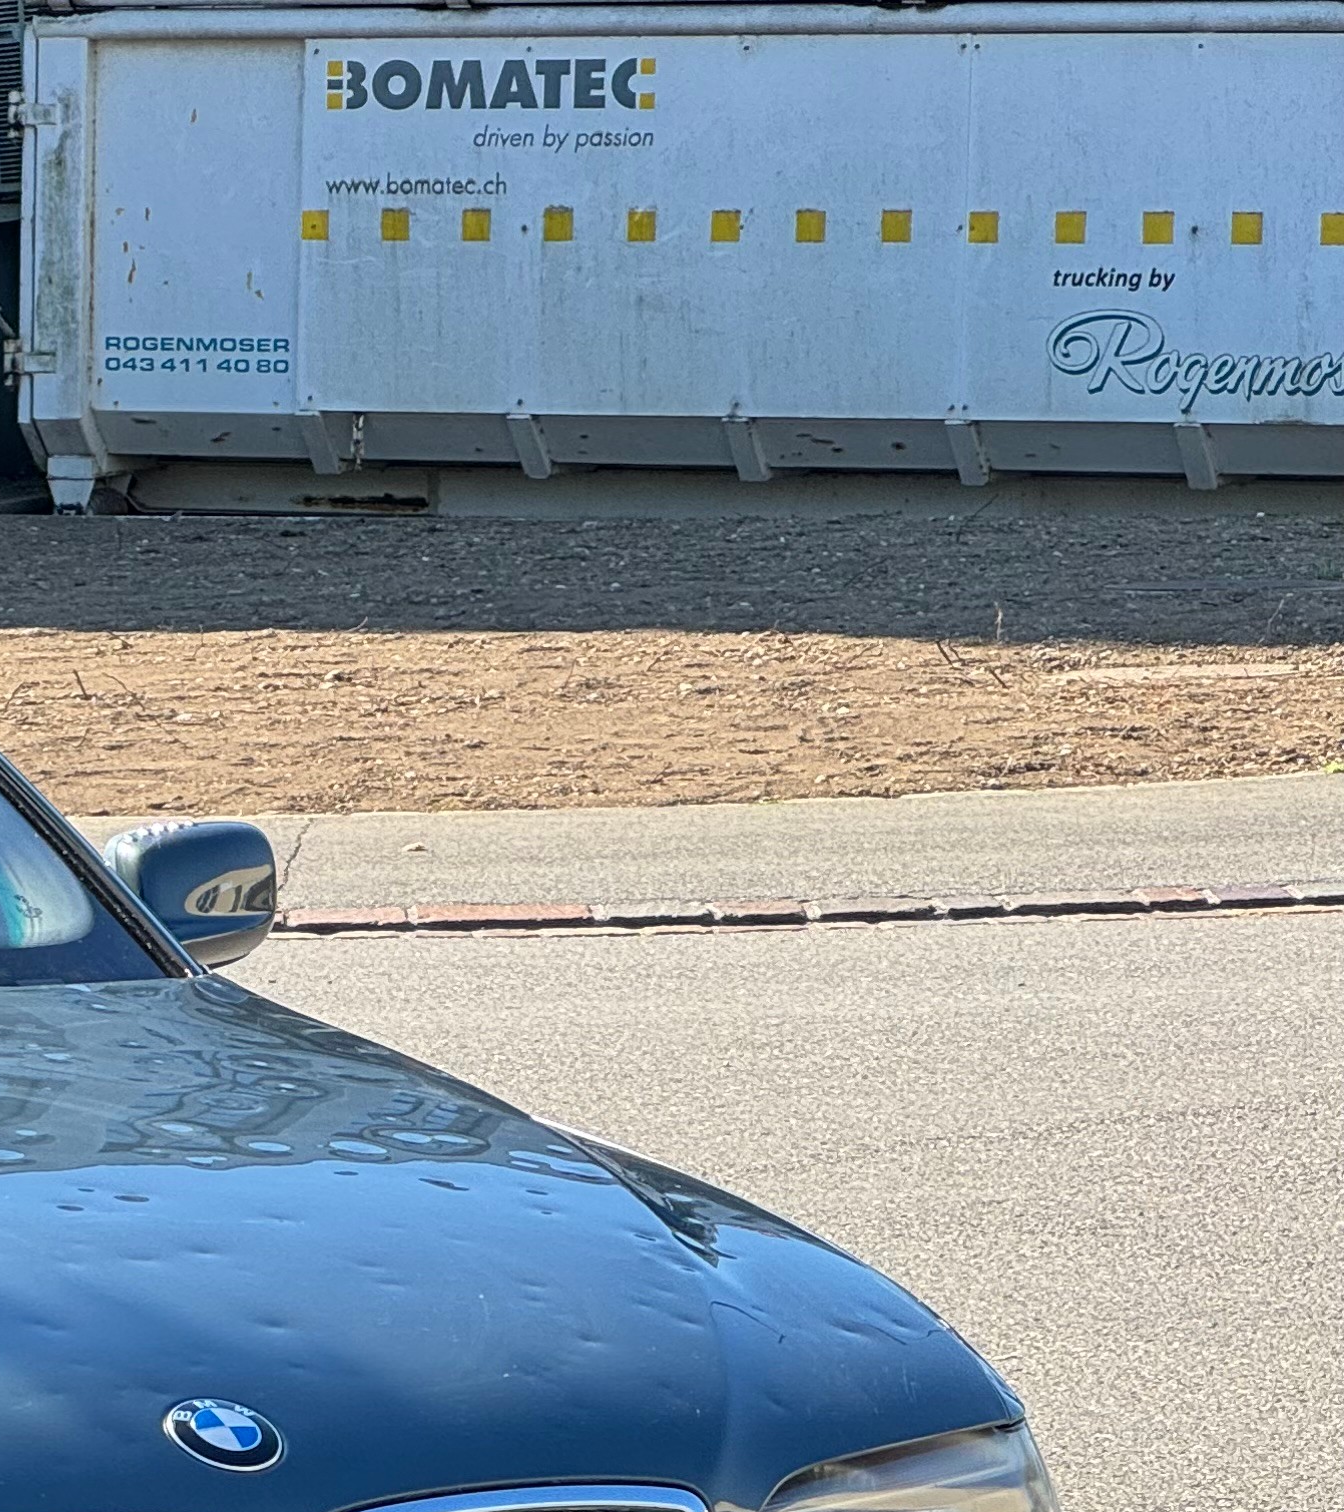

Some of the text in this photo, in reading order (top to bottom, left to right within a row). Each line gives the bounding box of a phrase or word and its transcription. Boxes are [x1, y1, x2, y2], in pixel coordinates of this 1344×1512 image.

[326, 57, 656, 110] BOMATEC
[473, 124, 654, 152] driven by passion
[325, 172, 507, 195] www.bomatec.ch
[1053, 267, 1176, 292] trucking by
[105, 336, 290, 352] ROGENMOSER
[105, 357, 289, 374] 043 411 40 80
[172, 1399, 256, 1421] BMW
